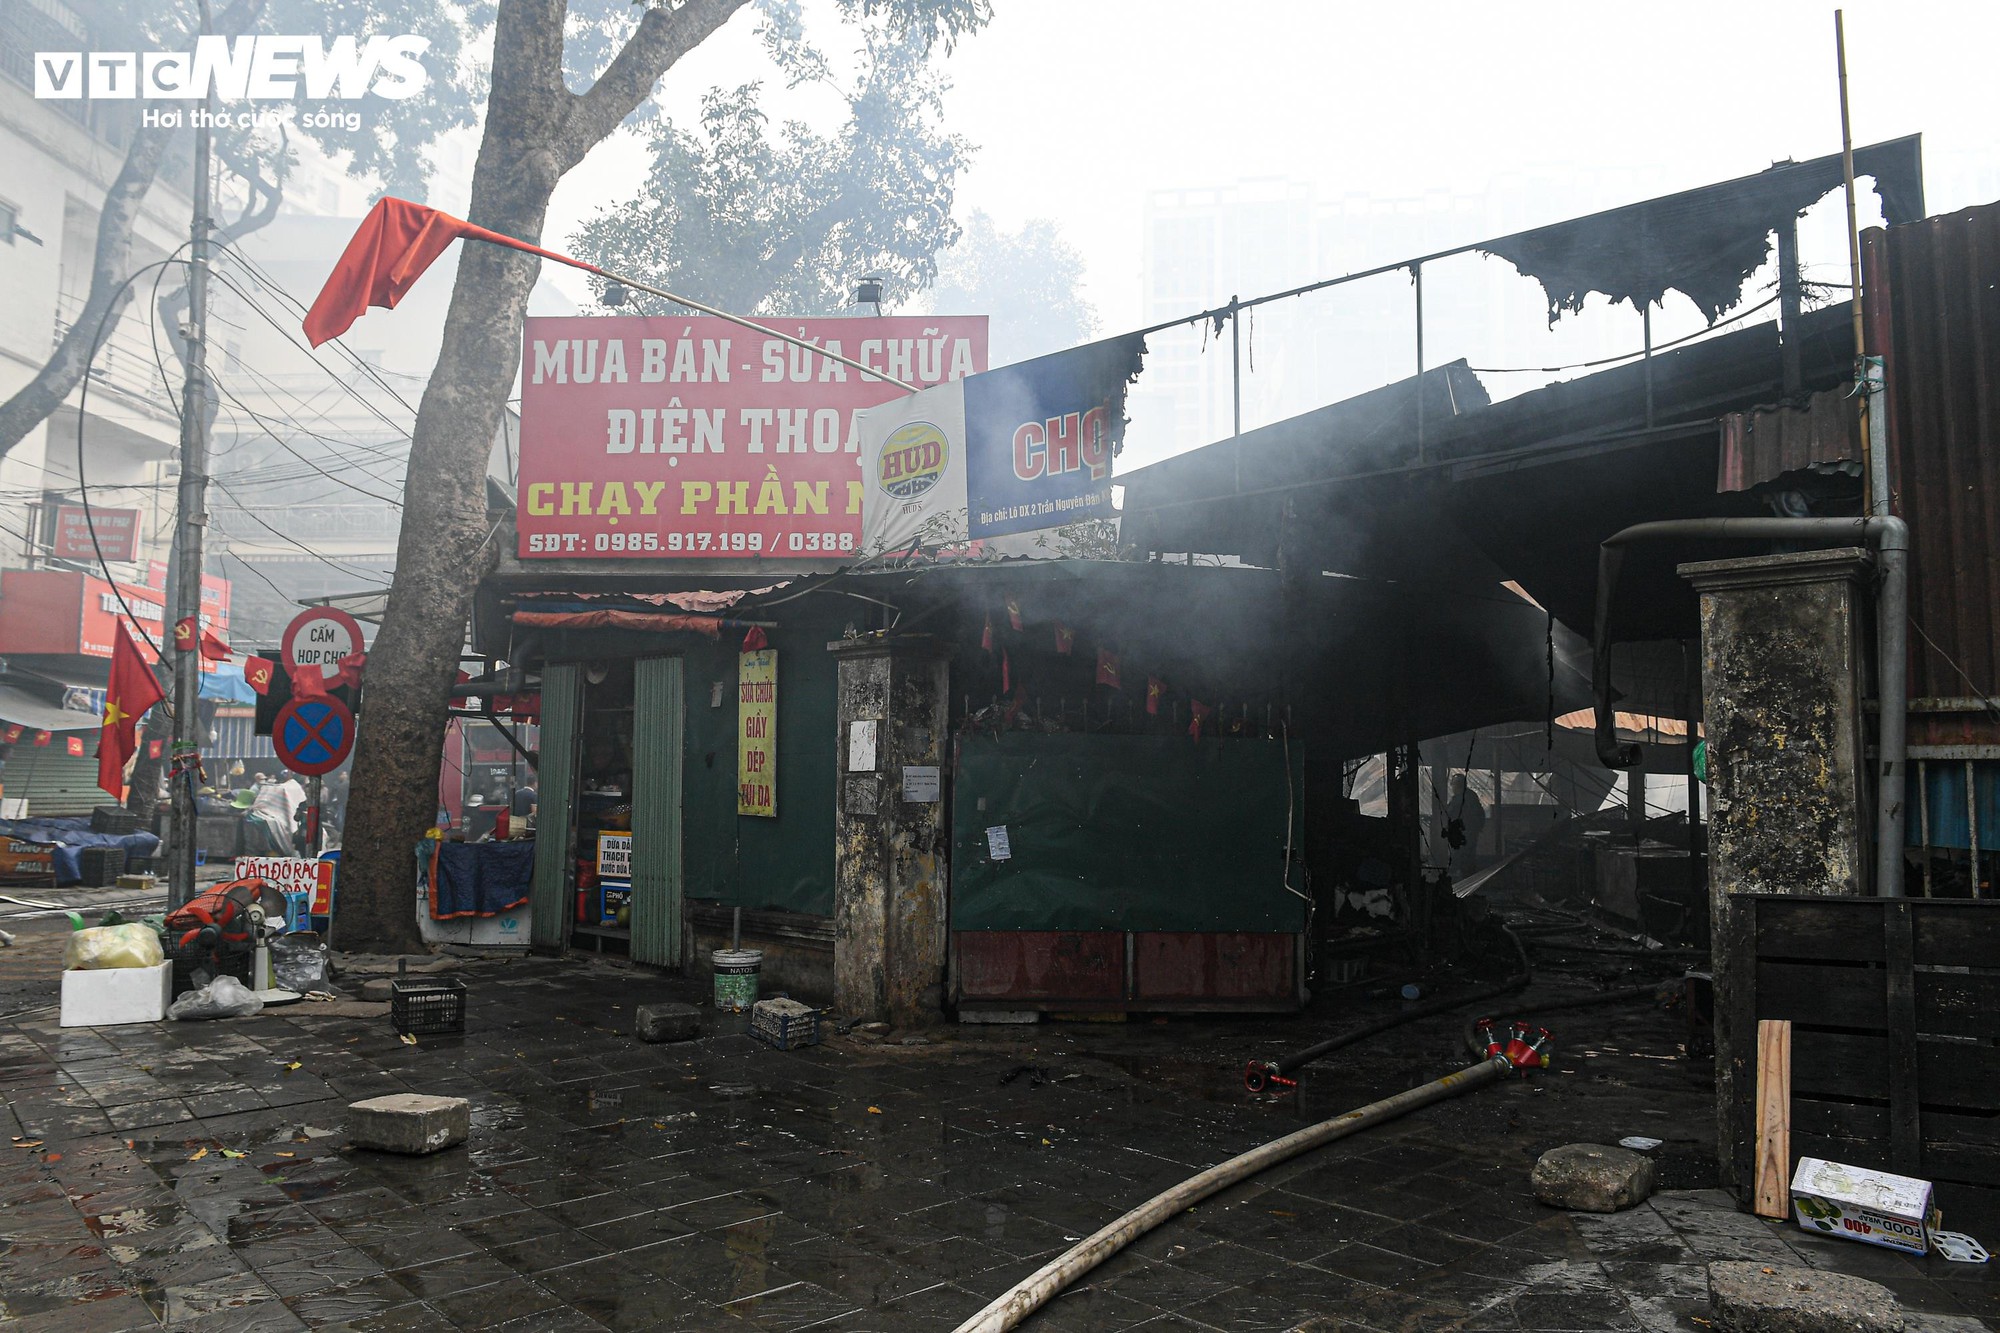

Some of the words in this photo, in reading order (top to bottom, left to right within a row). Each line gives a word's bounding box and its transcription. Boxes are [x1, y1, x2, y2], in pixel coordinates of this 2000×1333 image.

[532, 339, 629, 384] MUA
[640, 326, 731, 383] BÁN
[761, 326, 848, 383] SỬA
[859, 327, 977, 382] CHỮA
[606, 396, 726, 467] ĐIỆN
[882, 441, 941, 480] HUD
[527, 481, 666, 525] CHẠY
[680, 464, 830, 515] PHẦN
[981, 511, 993, 526] Địa
[1031, 502, 1037, 516] 2
[1038, 498, 1054, 515] Trần
[1055, 495, 1084, 512] Nguyên
[529, 533, 587, 552] SĐT:
[594, 532, 763, 551] 0985.917.199
[789, 532, 853, 551] 0388
[310, 624, 335, 642] CẤM
[741, 673, 754, 703] SỬA
[755, 675, 773, 703] CHỮA
[746, 746, 765, 773] DÉP
[741, 779, 756, 807] TÚI
[757, 784, 771, 808] DA
[236, 857, 269, 880] CẤM
[603, 851, 625, 863] THẠCH
[1843, 1218, 1872, 1234] 400
[1858, 1214, 1882, 1225] WRAP
[1883, 1220, 1922, 1238] FOOD
